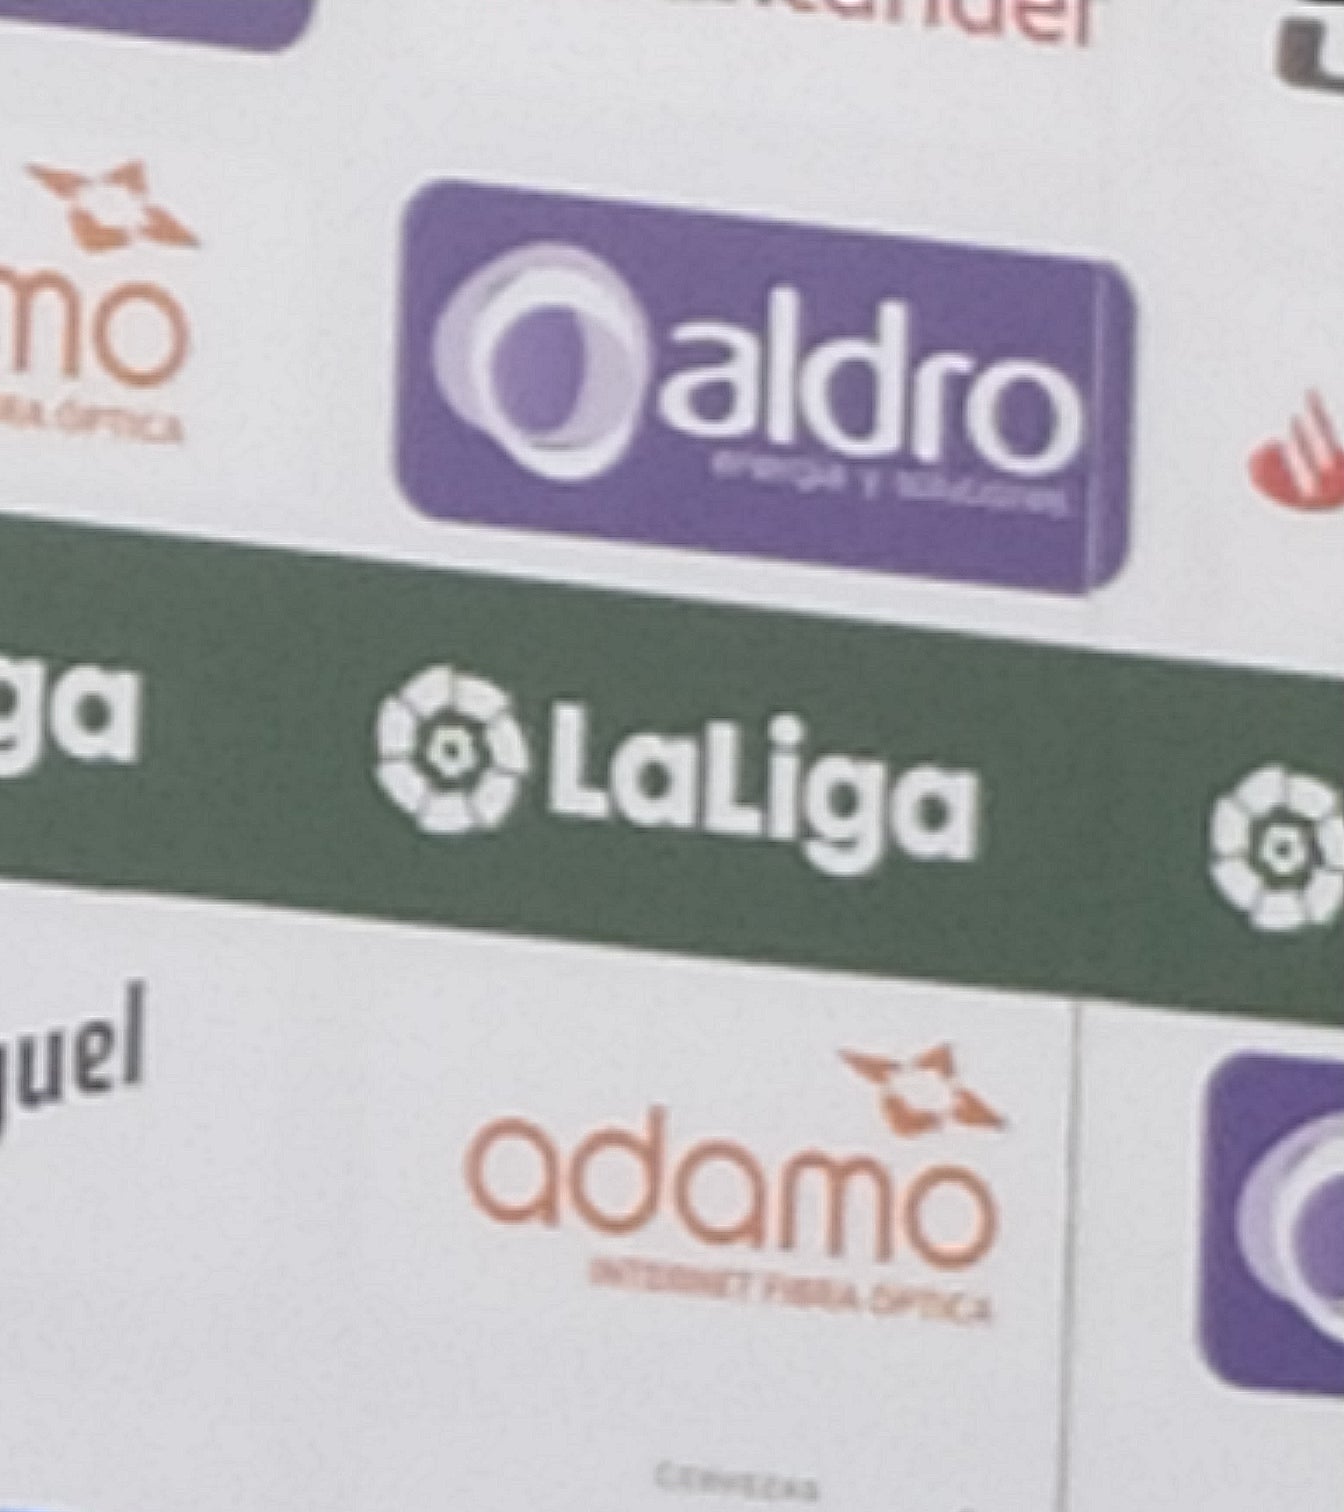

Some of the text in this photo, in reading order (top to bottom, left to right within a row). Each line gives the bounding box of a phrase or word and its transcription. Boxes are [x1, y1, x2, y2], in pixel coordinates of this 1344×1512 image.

[658, 284, 1086, 477] aldro
[549, 702, 982, 877] LaLiga
[465, 1105, 999, 1270] adamo
